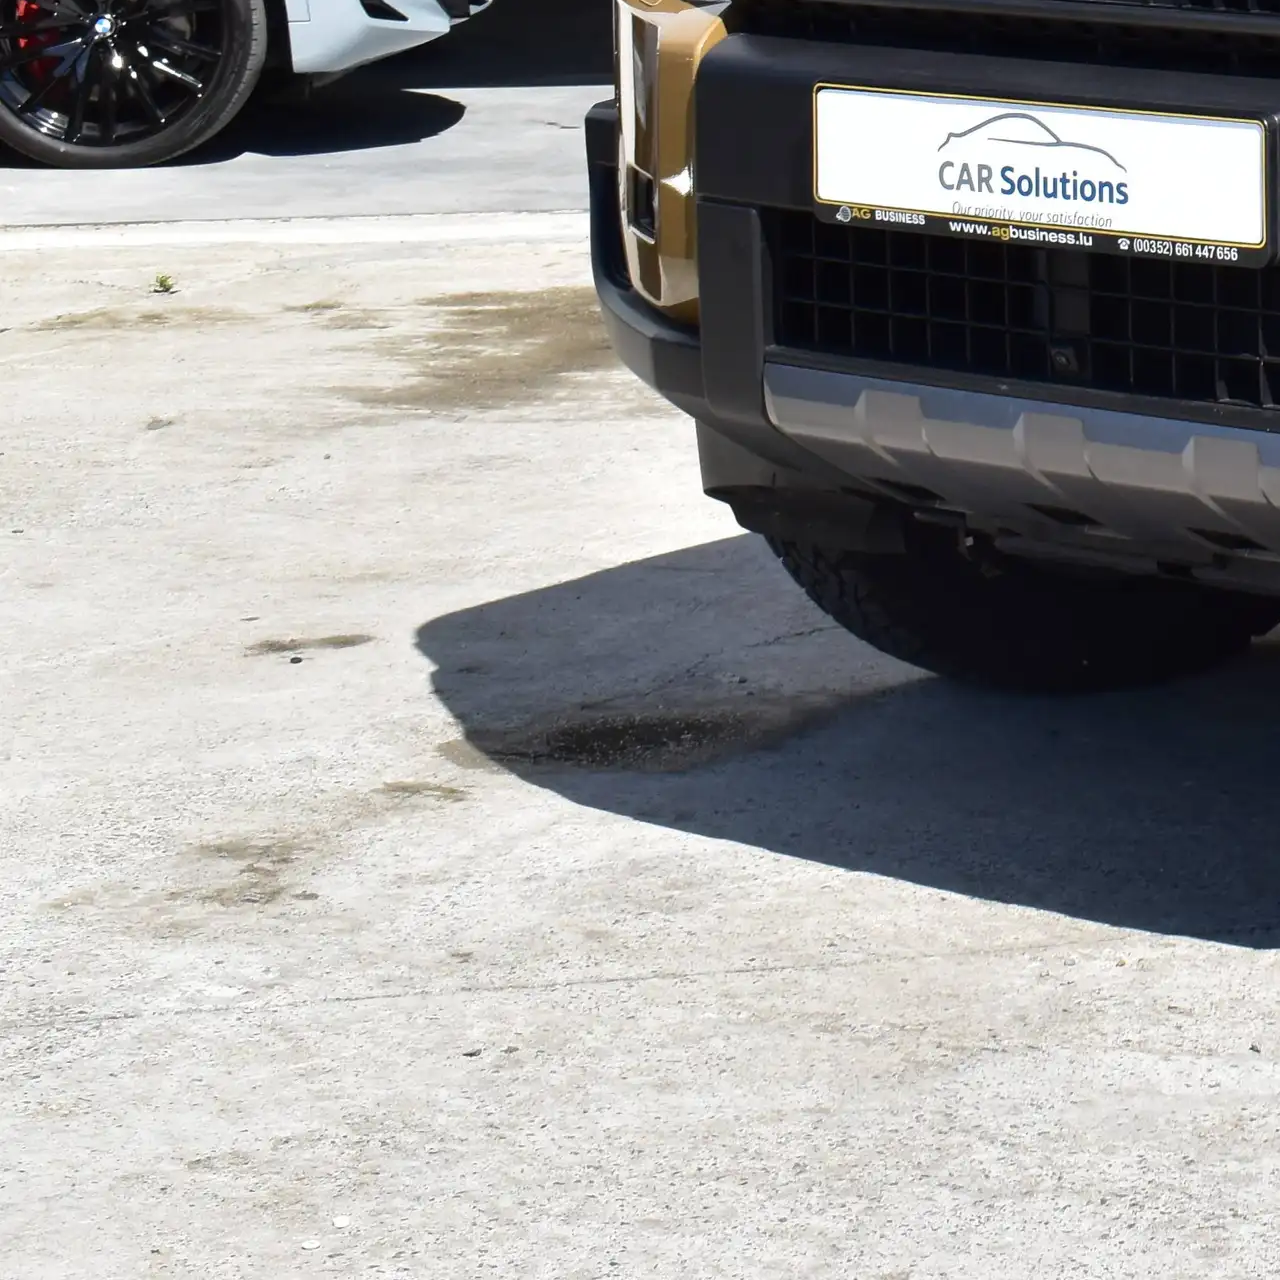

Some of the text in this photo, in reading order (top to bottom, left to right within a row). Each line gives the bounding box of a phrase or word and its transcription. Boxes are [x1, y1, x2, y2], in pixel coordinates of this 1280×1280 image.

[938, 161, 1129, 205] CAR Solutions
[851, 208, 925, 225] AG BUSINESS
[952, 201, 972, 215] Our
[1019, 210, 1043, 222] your
[1046, 210, 1113, 228] satisfaction
[949, 221, 1093, 247] www.agbusiness.lu
[1133, 237, 1238, 261] (00352) 661 447 656
